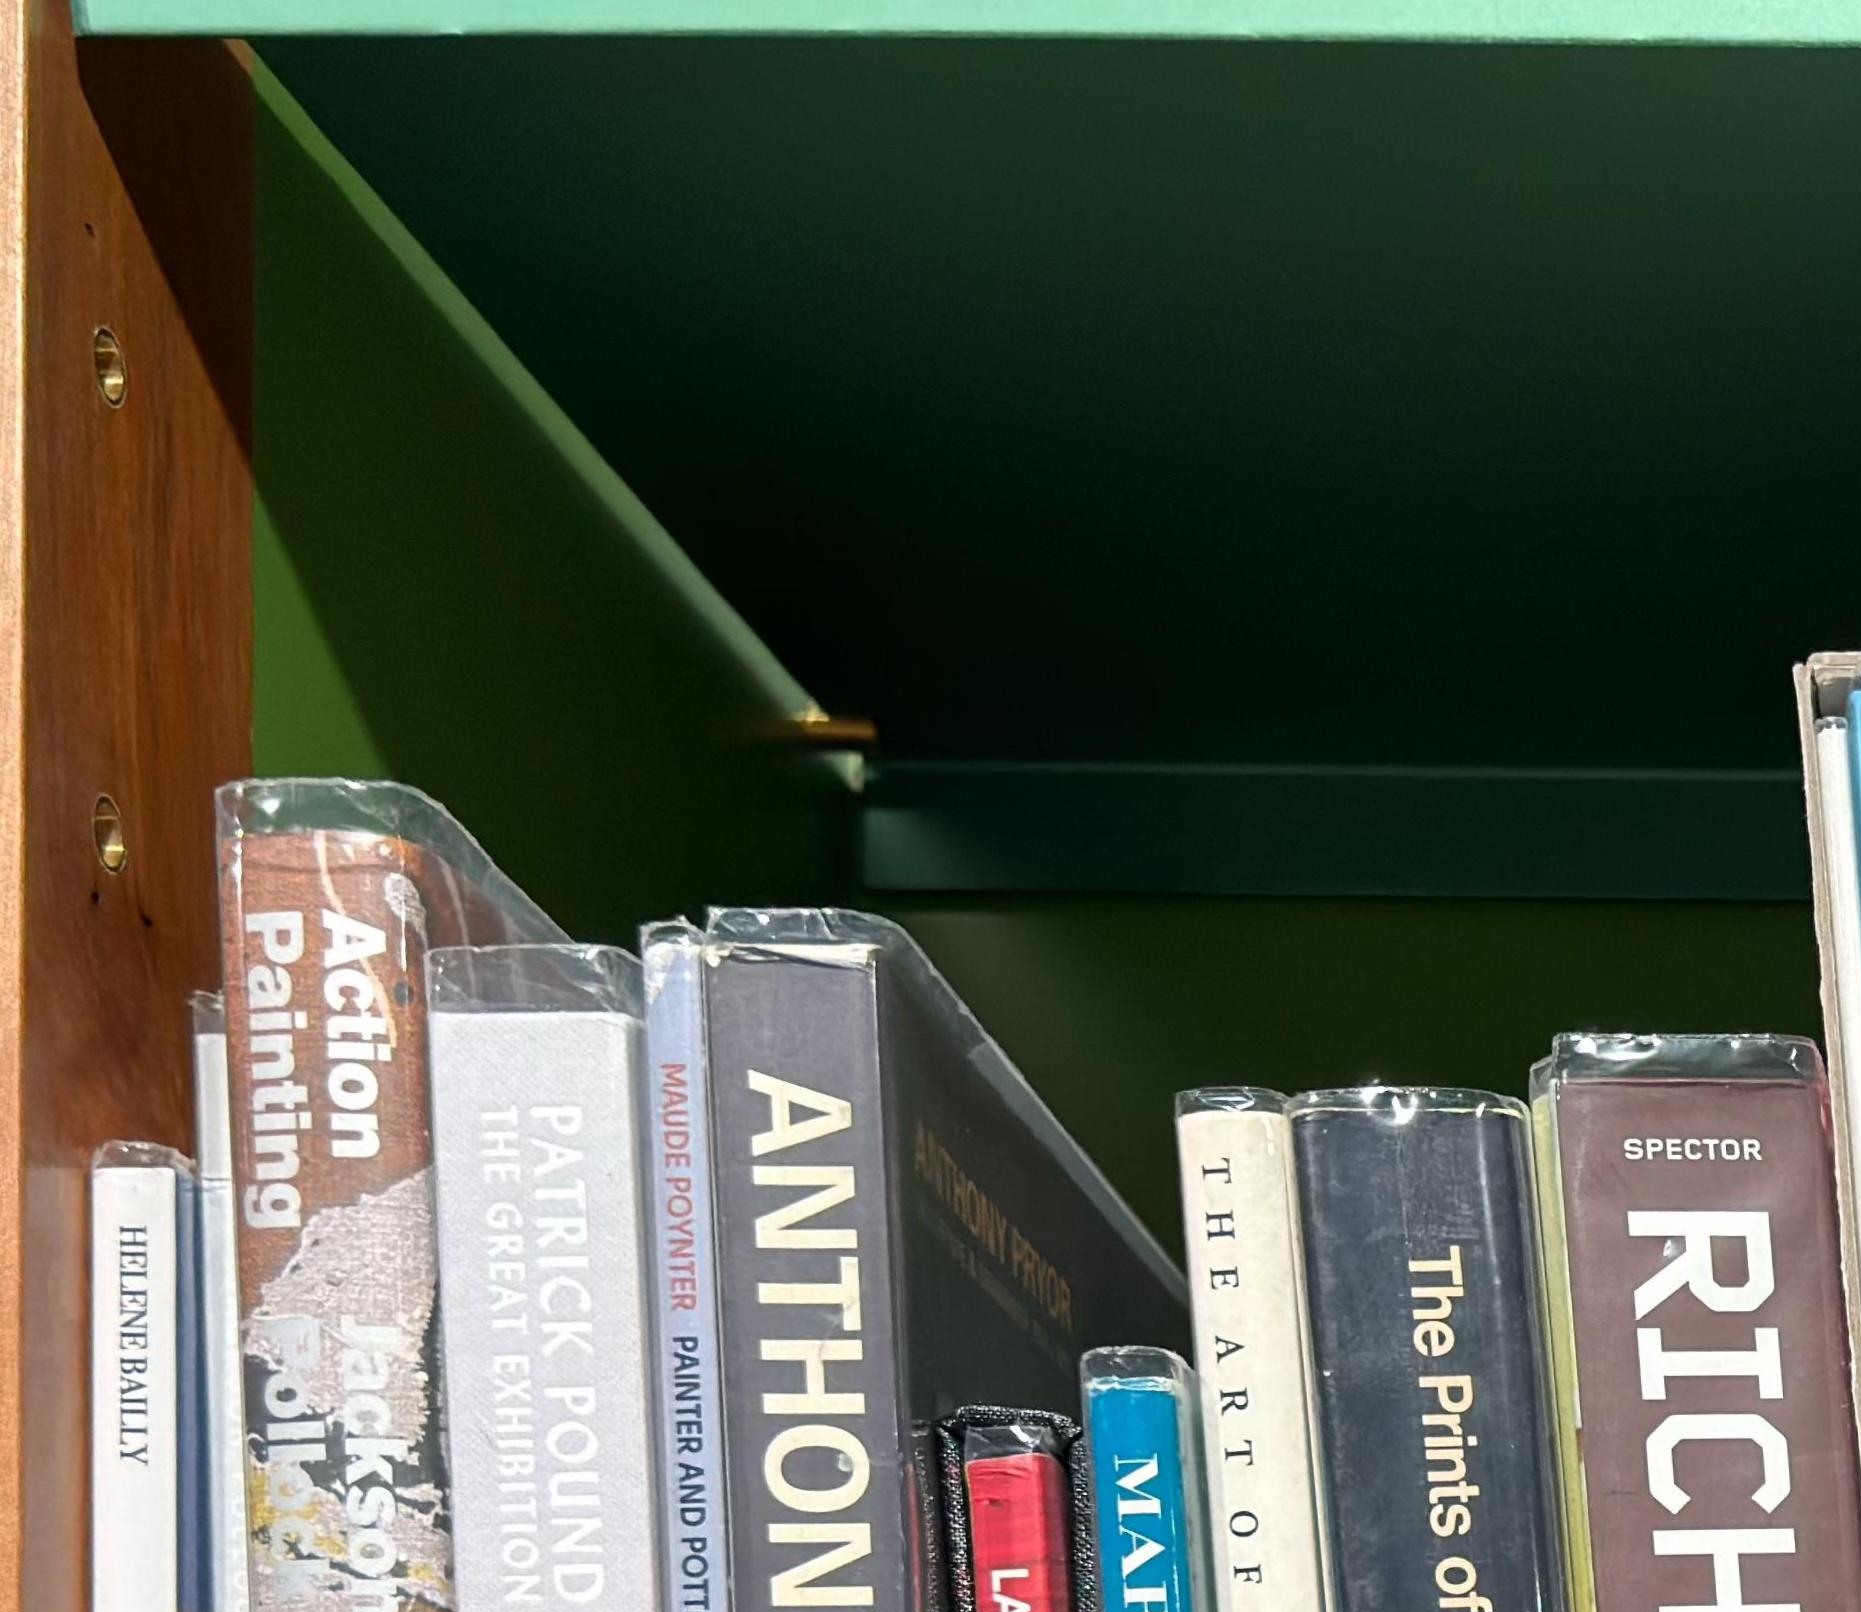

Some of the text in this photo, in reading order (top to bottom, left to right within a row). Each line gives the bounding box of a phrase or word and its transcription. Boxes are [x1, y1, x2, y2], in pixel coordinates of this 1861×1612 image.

[243, 909, 308, 1229] Painting
[321, 909, 388, 1158] Action
[661, 1062, 692, 1169] MAUDE
[1623, 1137, 1764, 1161] SPECTOR
[664, 1177, 697, 1312] POYNTER
[1200, 1157, 1240, 1290] THE
[119, 1225, 149, 1465] HELENE BAILLY
[480, 1105, 541, 1604] THE GREAT EXHIBITION
[529, 1107, 604, 1603] PATRICK POUND
[1408, 1245, 1464, 1357] The
[249, 1315, 327, 1600] Pollock
[671, 1335, 704, 1454] PAINTER
[1213, 1333, 1254, 1466] ART
[1418, 1373, 1481, 1538] Prints
[676, 1462, 708, 1527] AND
[1228, 1509, 1263, 1586] OF
